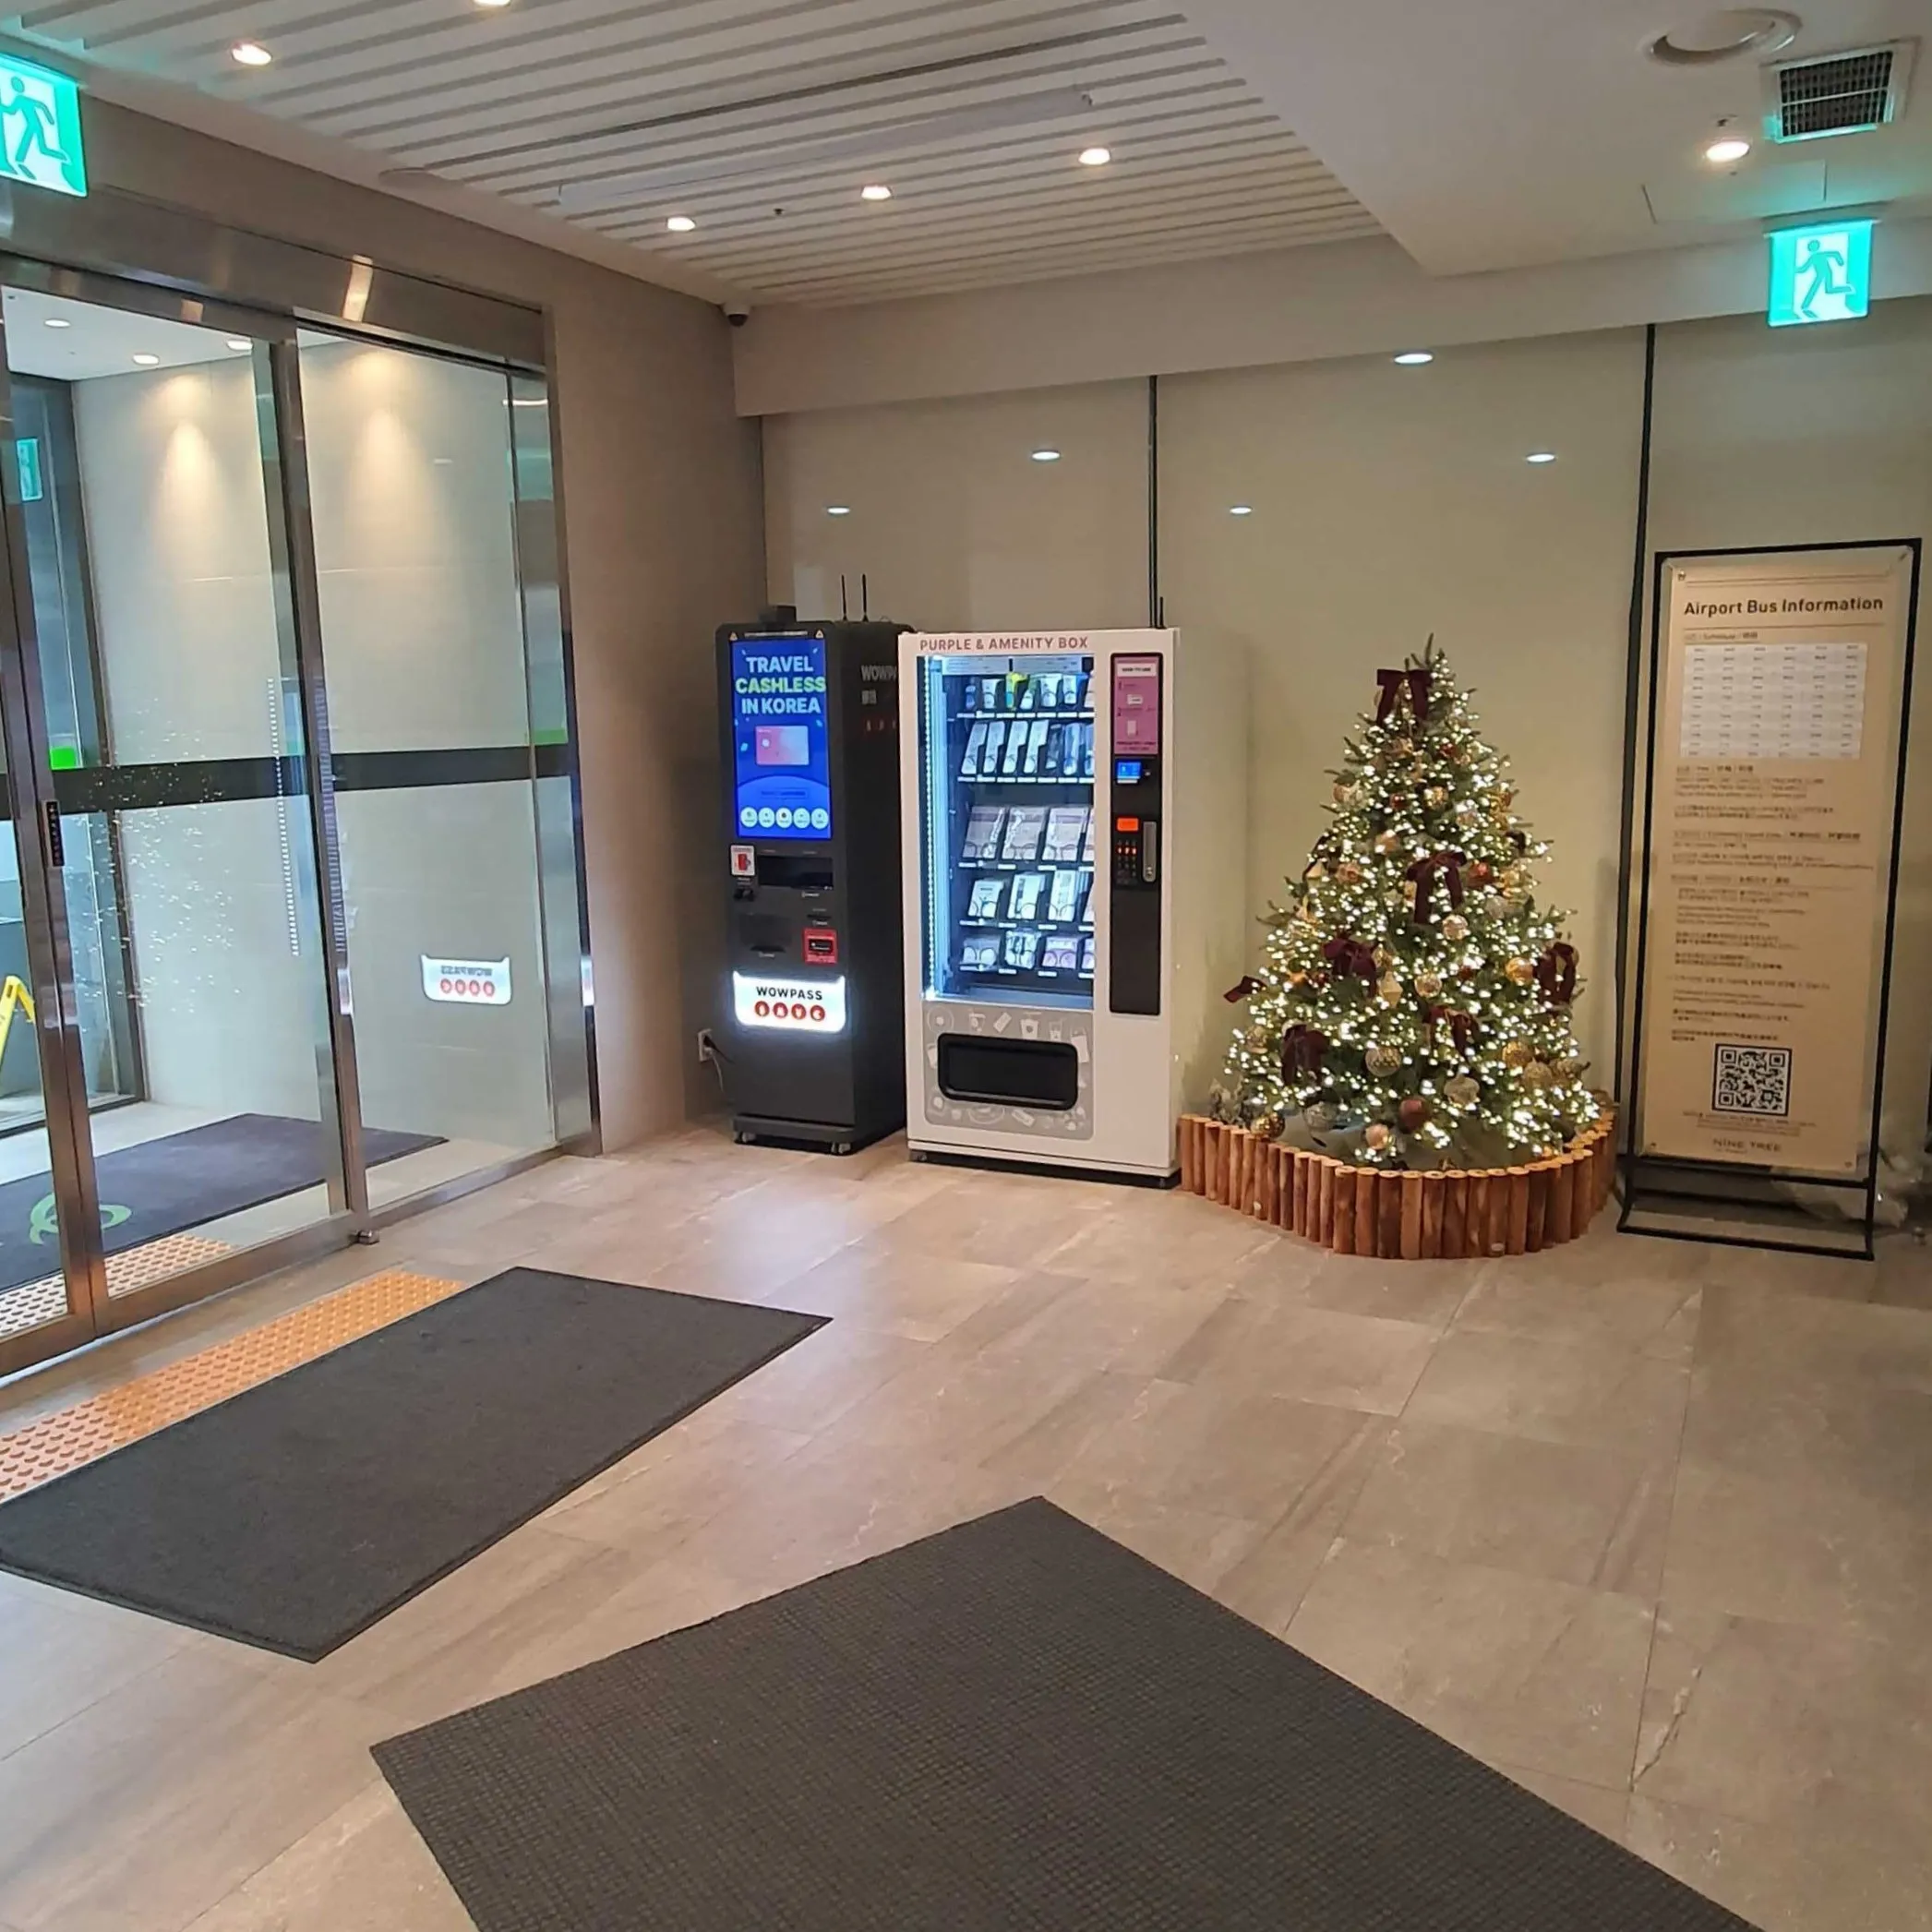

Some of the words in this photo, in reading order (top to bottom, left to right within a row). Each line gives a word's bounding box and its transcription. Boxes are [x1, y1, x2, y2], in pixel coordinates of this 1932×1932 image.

[1684, 602, 1742, 618] Airport
[1747, 599, 1778, 613] Bus
[1782, 596, 1884, 612] Information
[919, 639, 971, 651] PURPLE
[976, 638, 985, 650] &
[989, 637, 1054, 650] AMENITY
[1059, 636, 1089, 649] BOX
[745, 655, 814, 673] TRAVEL
[735, 676, 826, 694] CASHLESS
[741, 698, 759, 714] IN
[762, 697, 822, 714] KOREA
[756, 986, 823, 1001] WOWPASS
